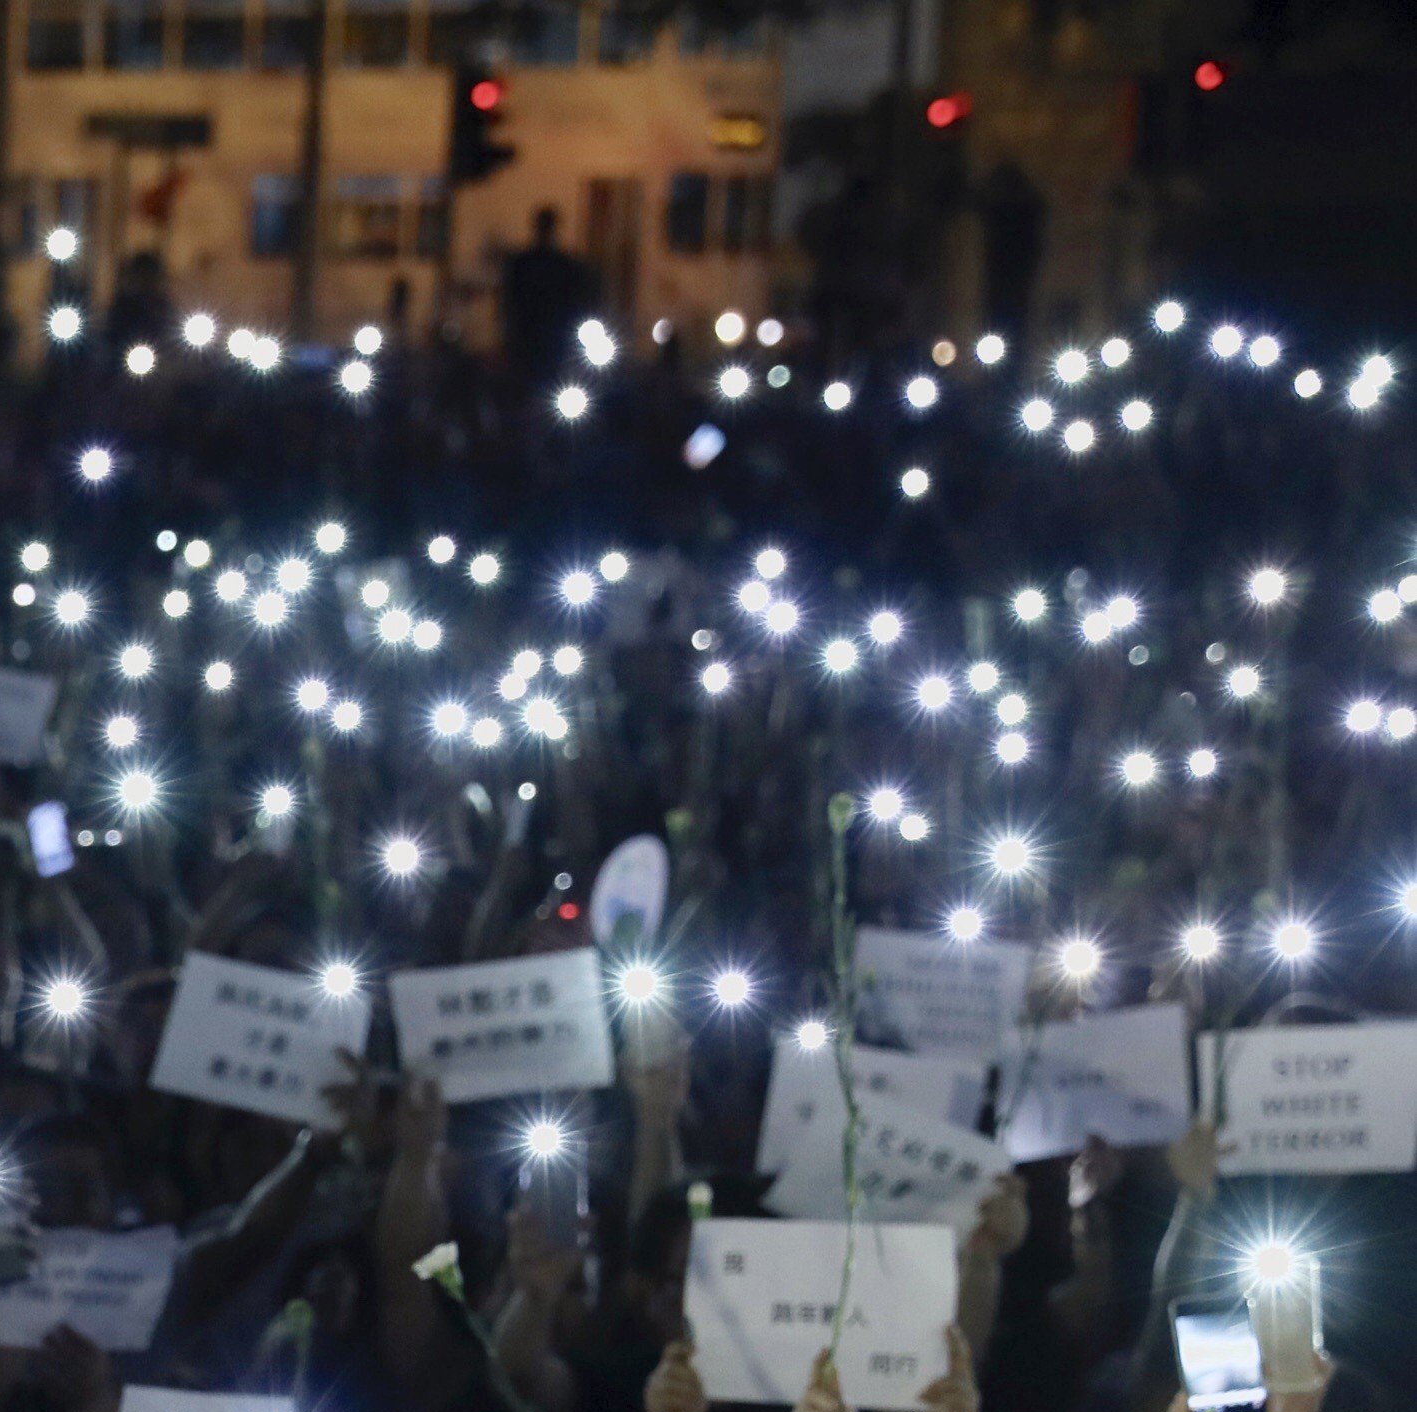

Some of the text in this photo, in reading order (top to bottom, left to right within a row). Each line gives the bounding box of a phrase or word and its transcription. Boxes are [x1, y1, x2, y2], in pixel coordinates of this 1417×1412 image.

[1272, 1052, 1354, 1079] STOP
[1260, 1091, 1361, 1119] WHITE
[1249, 1127, 1366, 1153] TERROR
[869, 1351, 916, 1375] 同行
